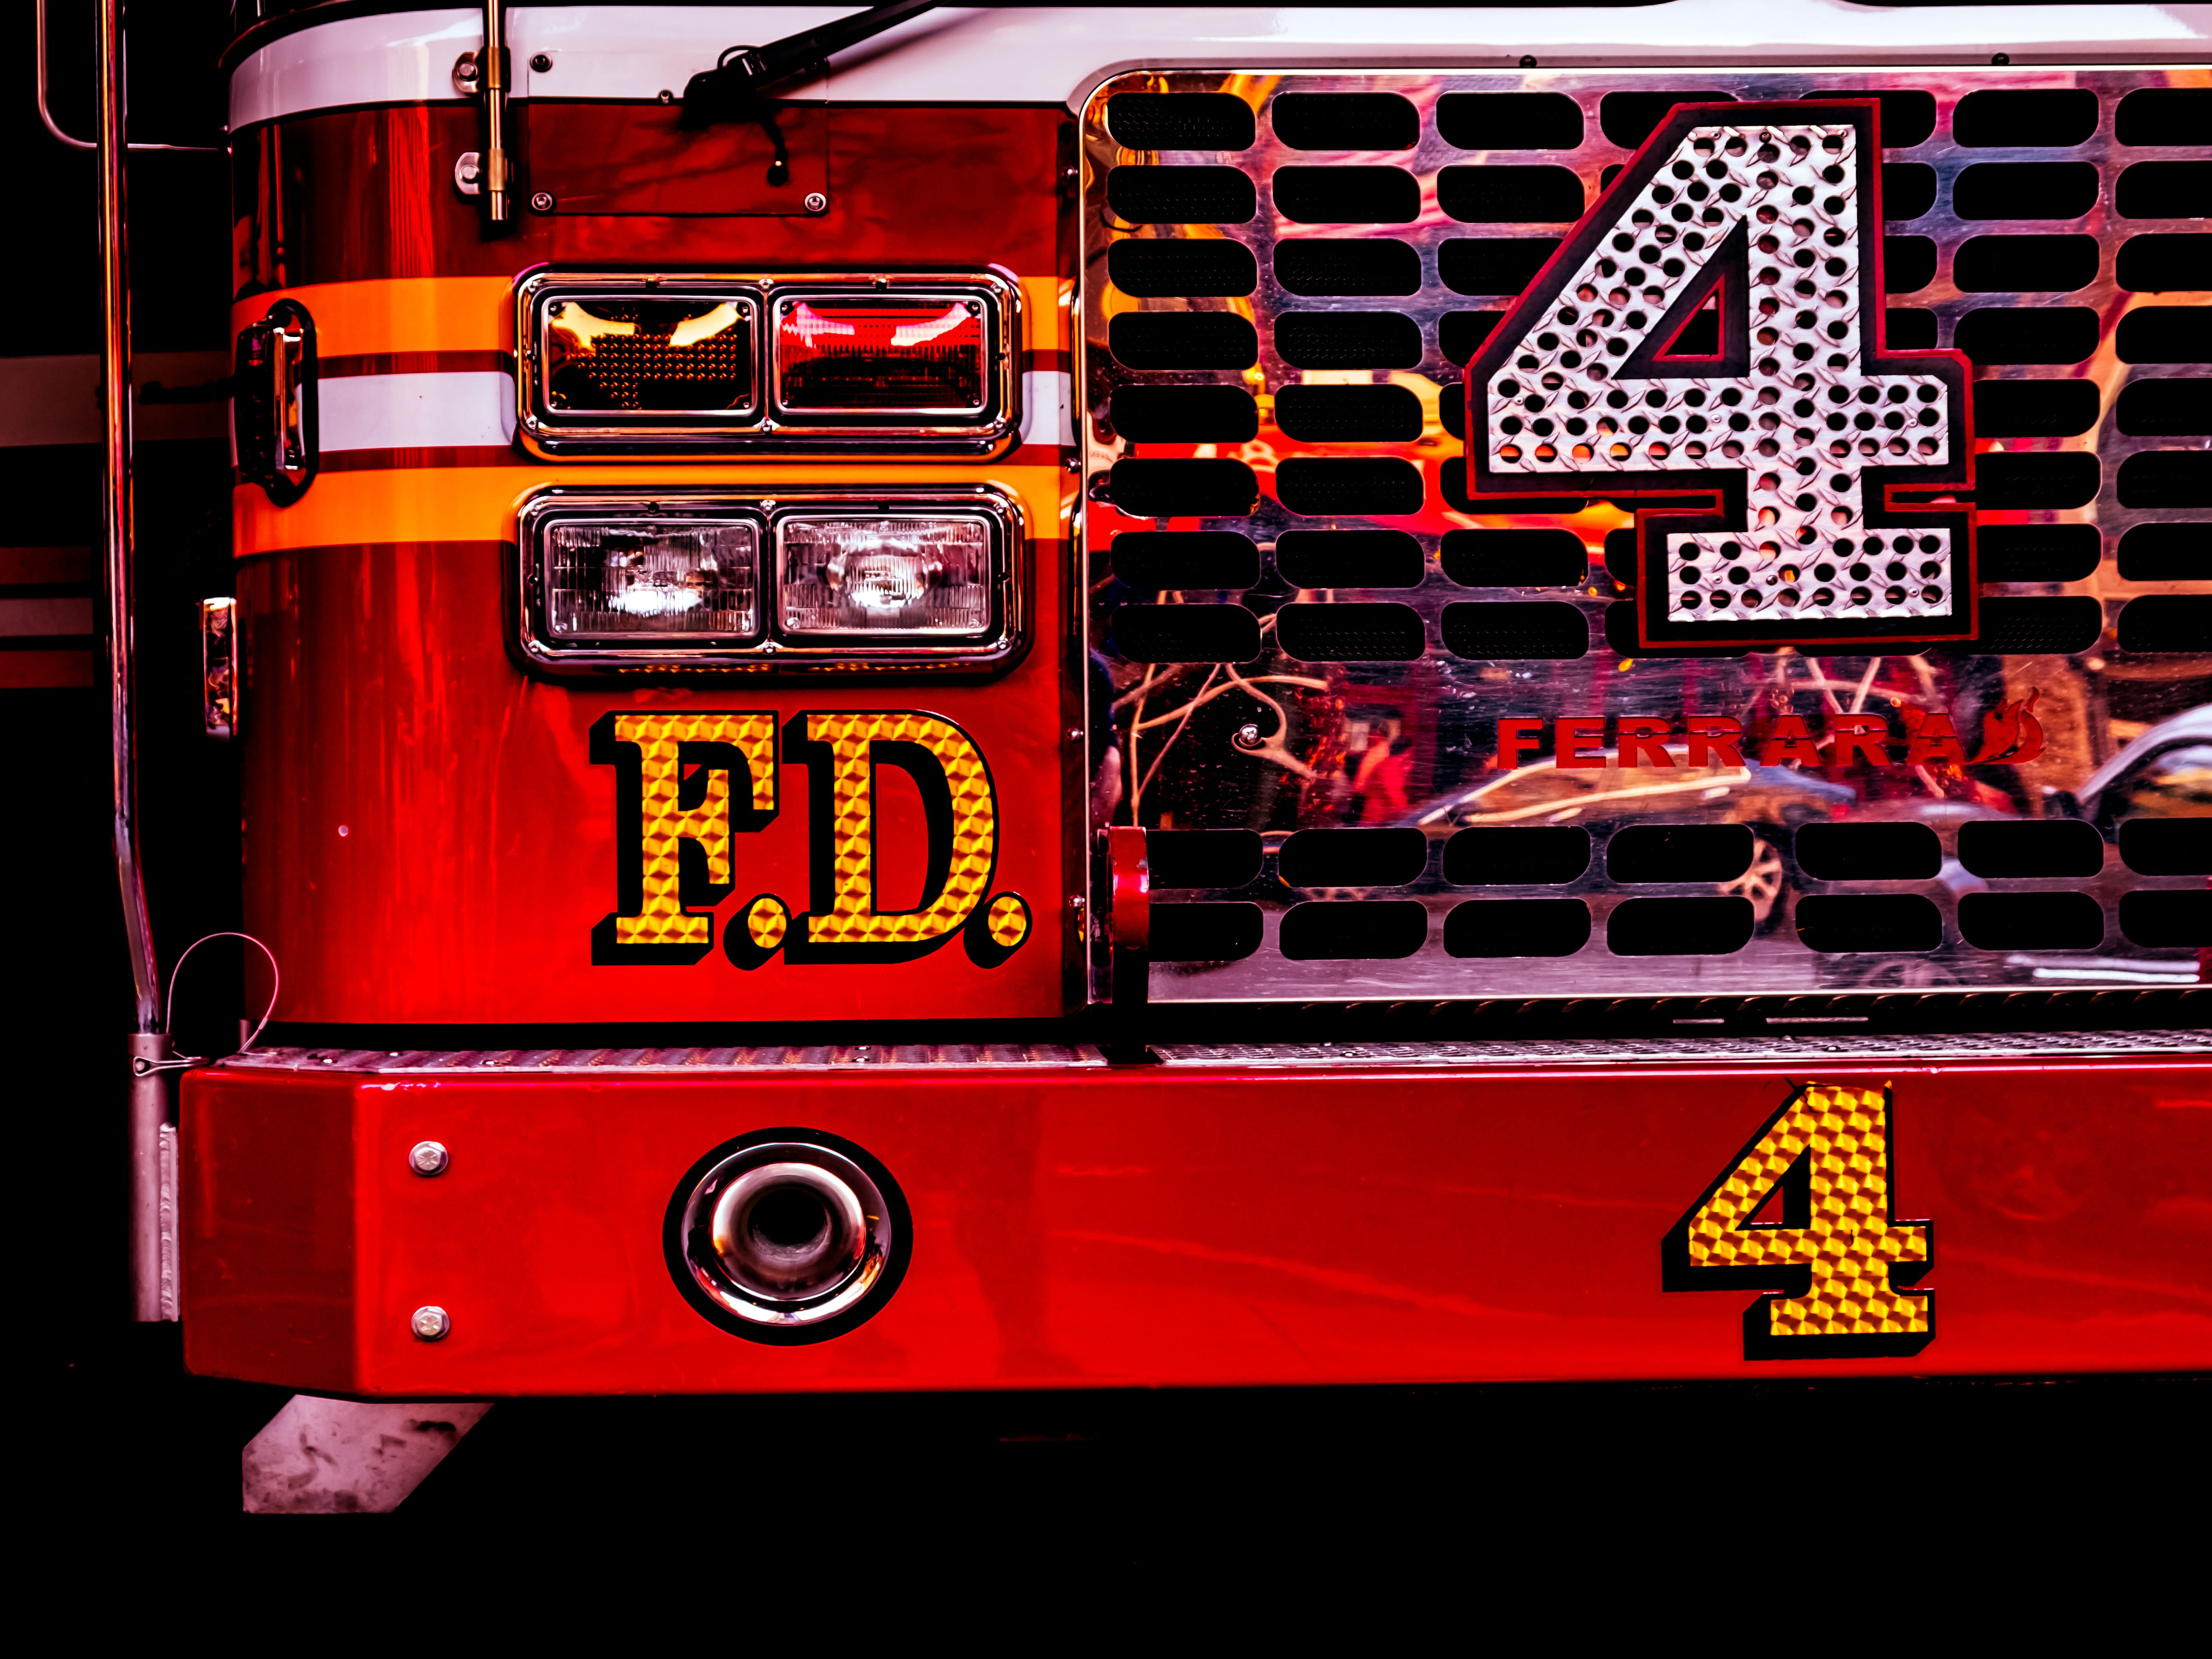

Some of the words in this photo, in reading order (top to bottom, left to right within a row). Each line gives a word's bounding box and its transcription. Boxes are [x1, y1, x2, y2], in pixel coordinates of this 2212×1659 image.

[1488, 125, 1952, 622] 4
[615, 714, 1028, 949] F.D.
[1496, 711, 1969, 770] FERRARA
[1689, 1080, 1928, 1335] 4
